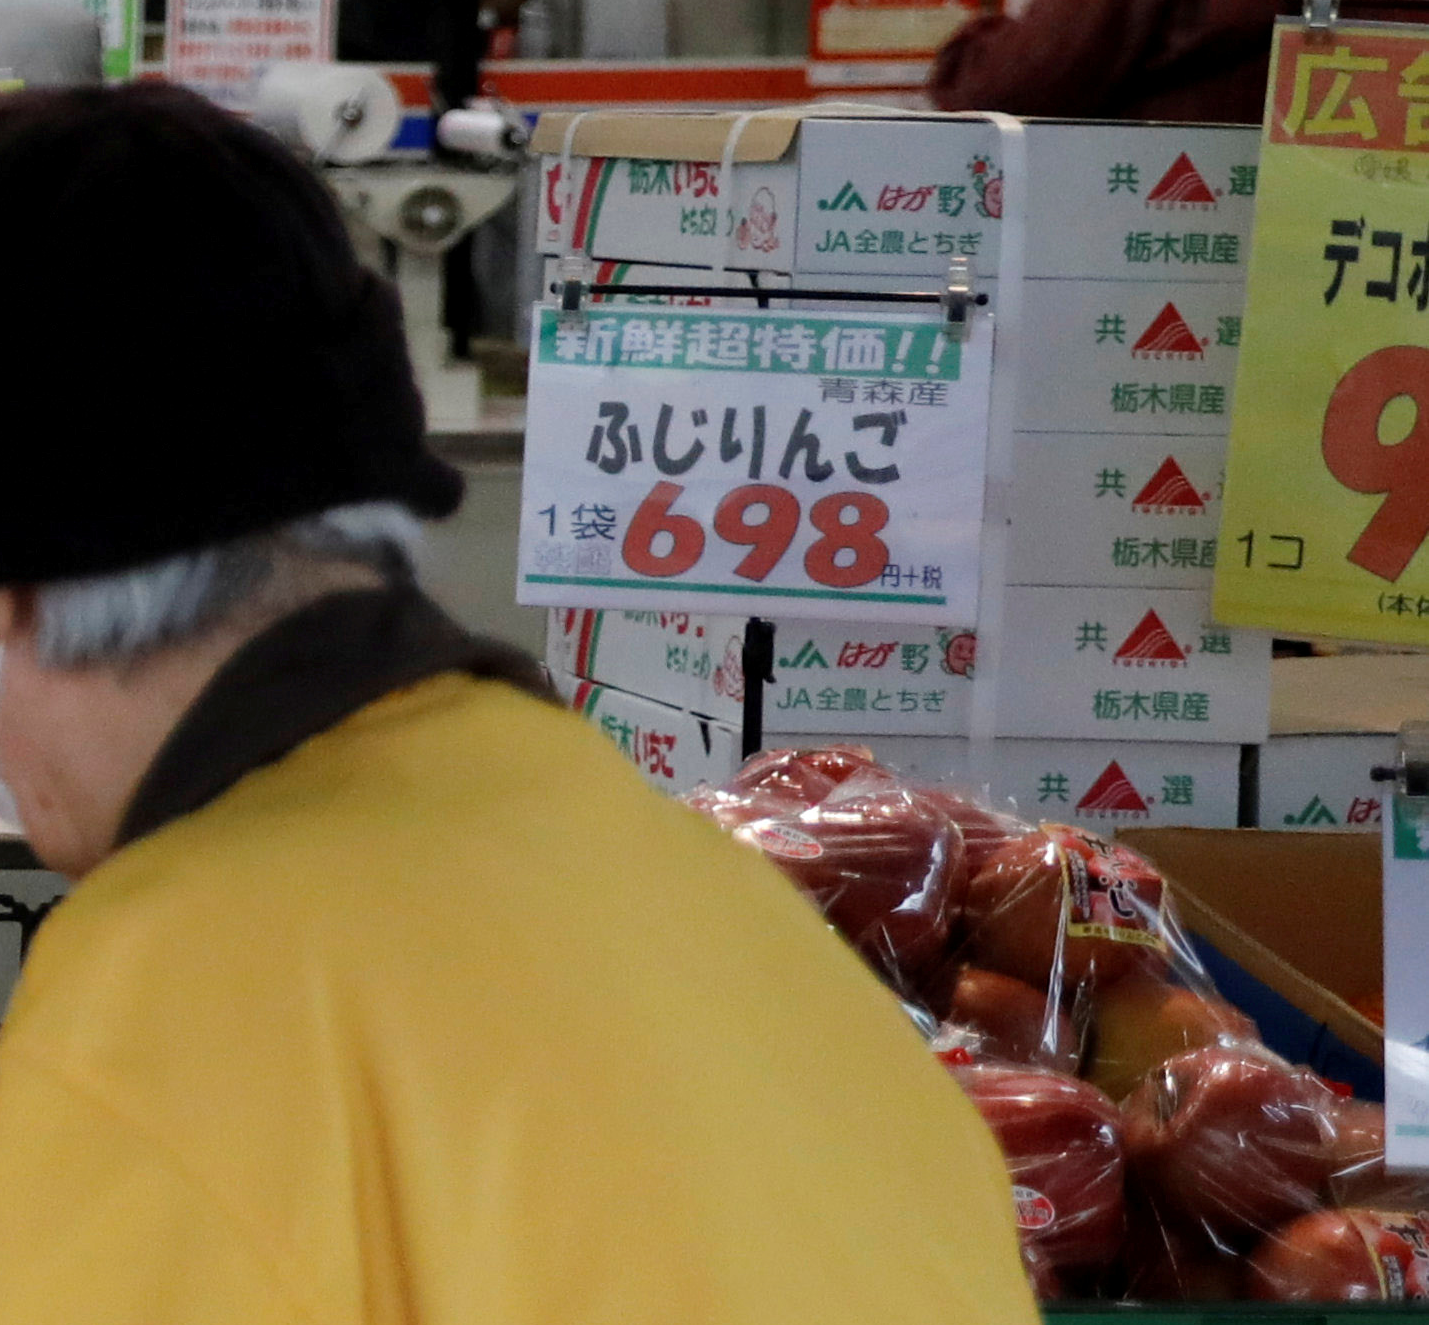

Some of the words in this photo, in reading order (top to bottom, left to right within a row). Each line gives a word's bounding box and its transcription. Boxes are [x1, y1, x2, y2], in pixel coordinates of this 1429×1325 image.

[1108, 164, 1139, 194] 共
[815, 230, 982, 256] JA全農とちぎ
[1124, 232, 1240, 265] 栃木県産
[1096, 314, 1126, 345] 共
[816, 379, 950, 408] 青森産
[1111, 383, 1225, 415] 栃木県産
[585, 400, 909, 485] ふじりんご
[1096, 468, 1127, 500] 共
[539, 502, 617, 542] 1袋
[621, 481, 891, 588] 698
[1237, 530, 1305, 571] 1コ
[1076, 621, 1108, 652] 共
[777, 687, 947, 713] JA全農とちぎ
[1092, 688, 1211, 722] 栃木県産
[1038, 773, 1069, 803] 共
[1161, 775, 1194, 805] 選
